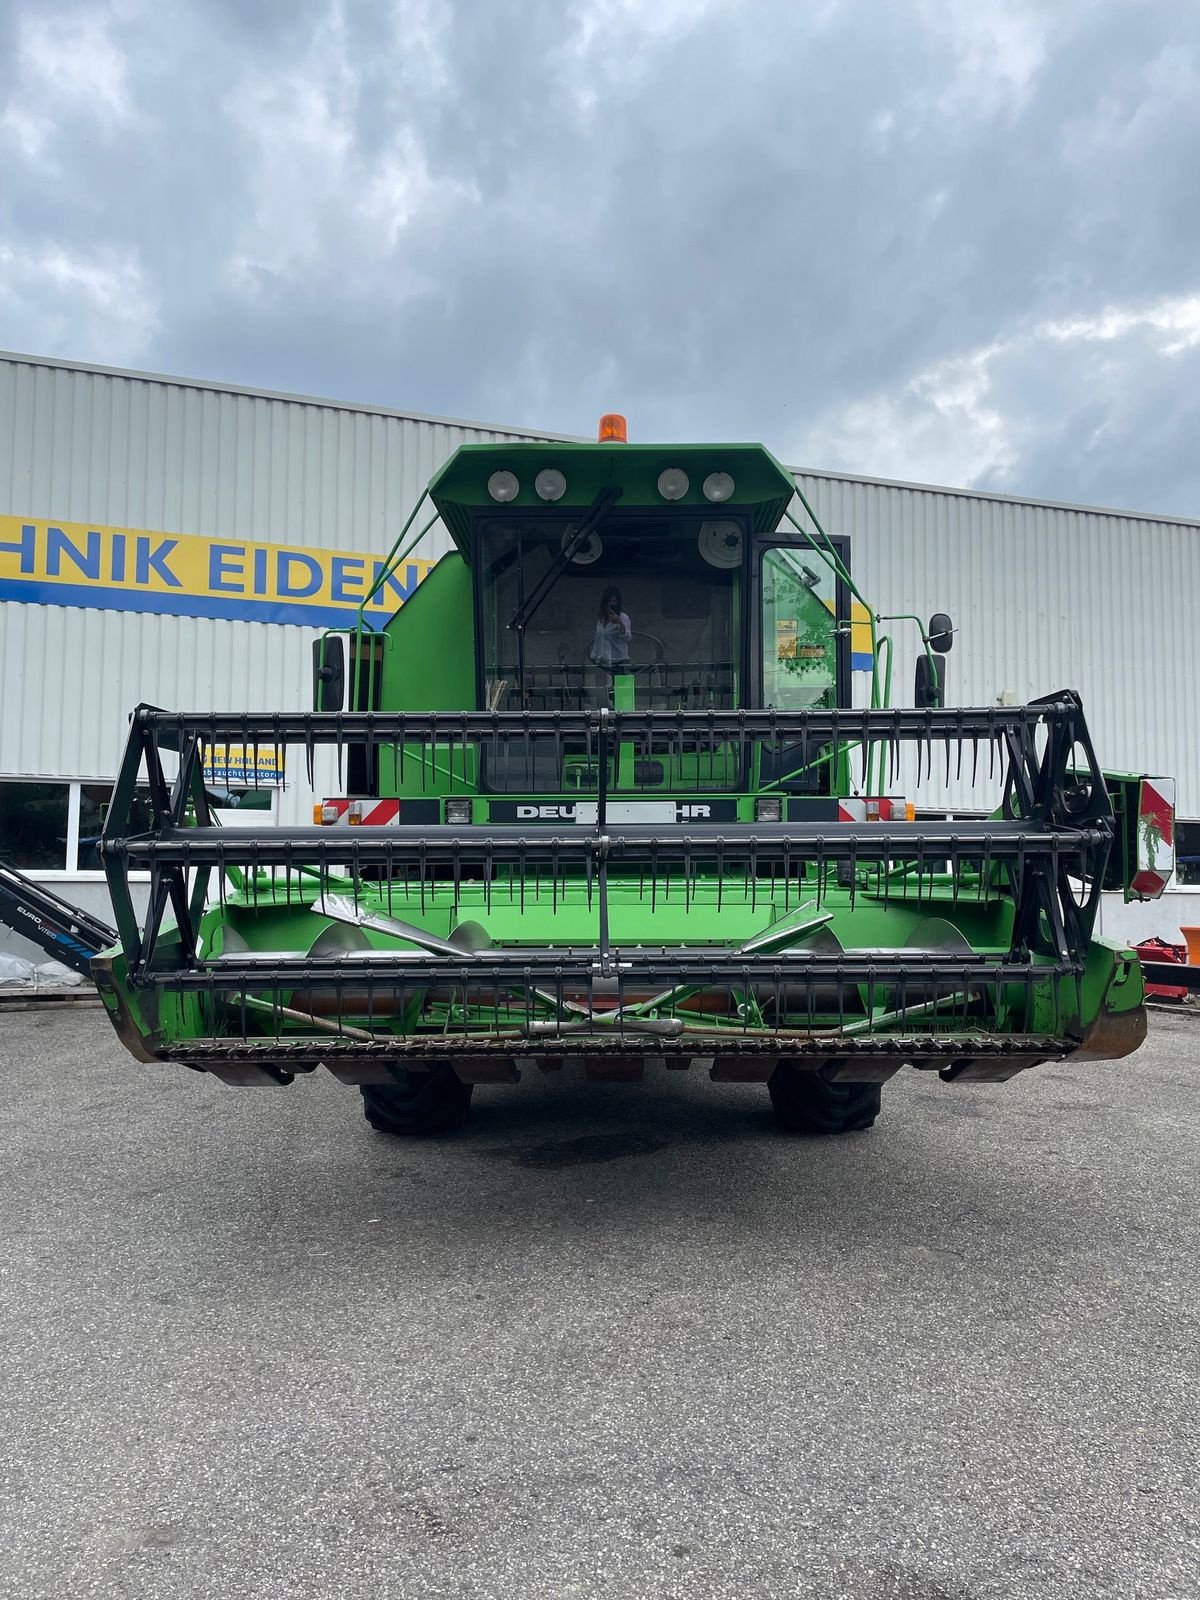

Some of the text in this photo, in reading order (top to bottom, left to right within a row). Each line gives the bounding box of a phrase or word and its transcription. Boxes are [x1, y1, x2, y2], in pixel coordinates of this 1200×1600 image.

[0, 525, 433, 605] HNIK EIDEN
[235, 757, 278, 767] HOLAND
[16, 906, 42, 924] EURO
